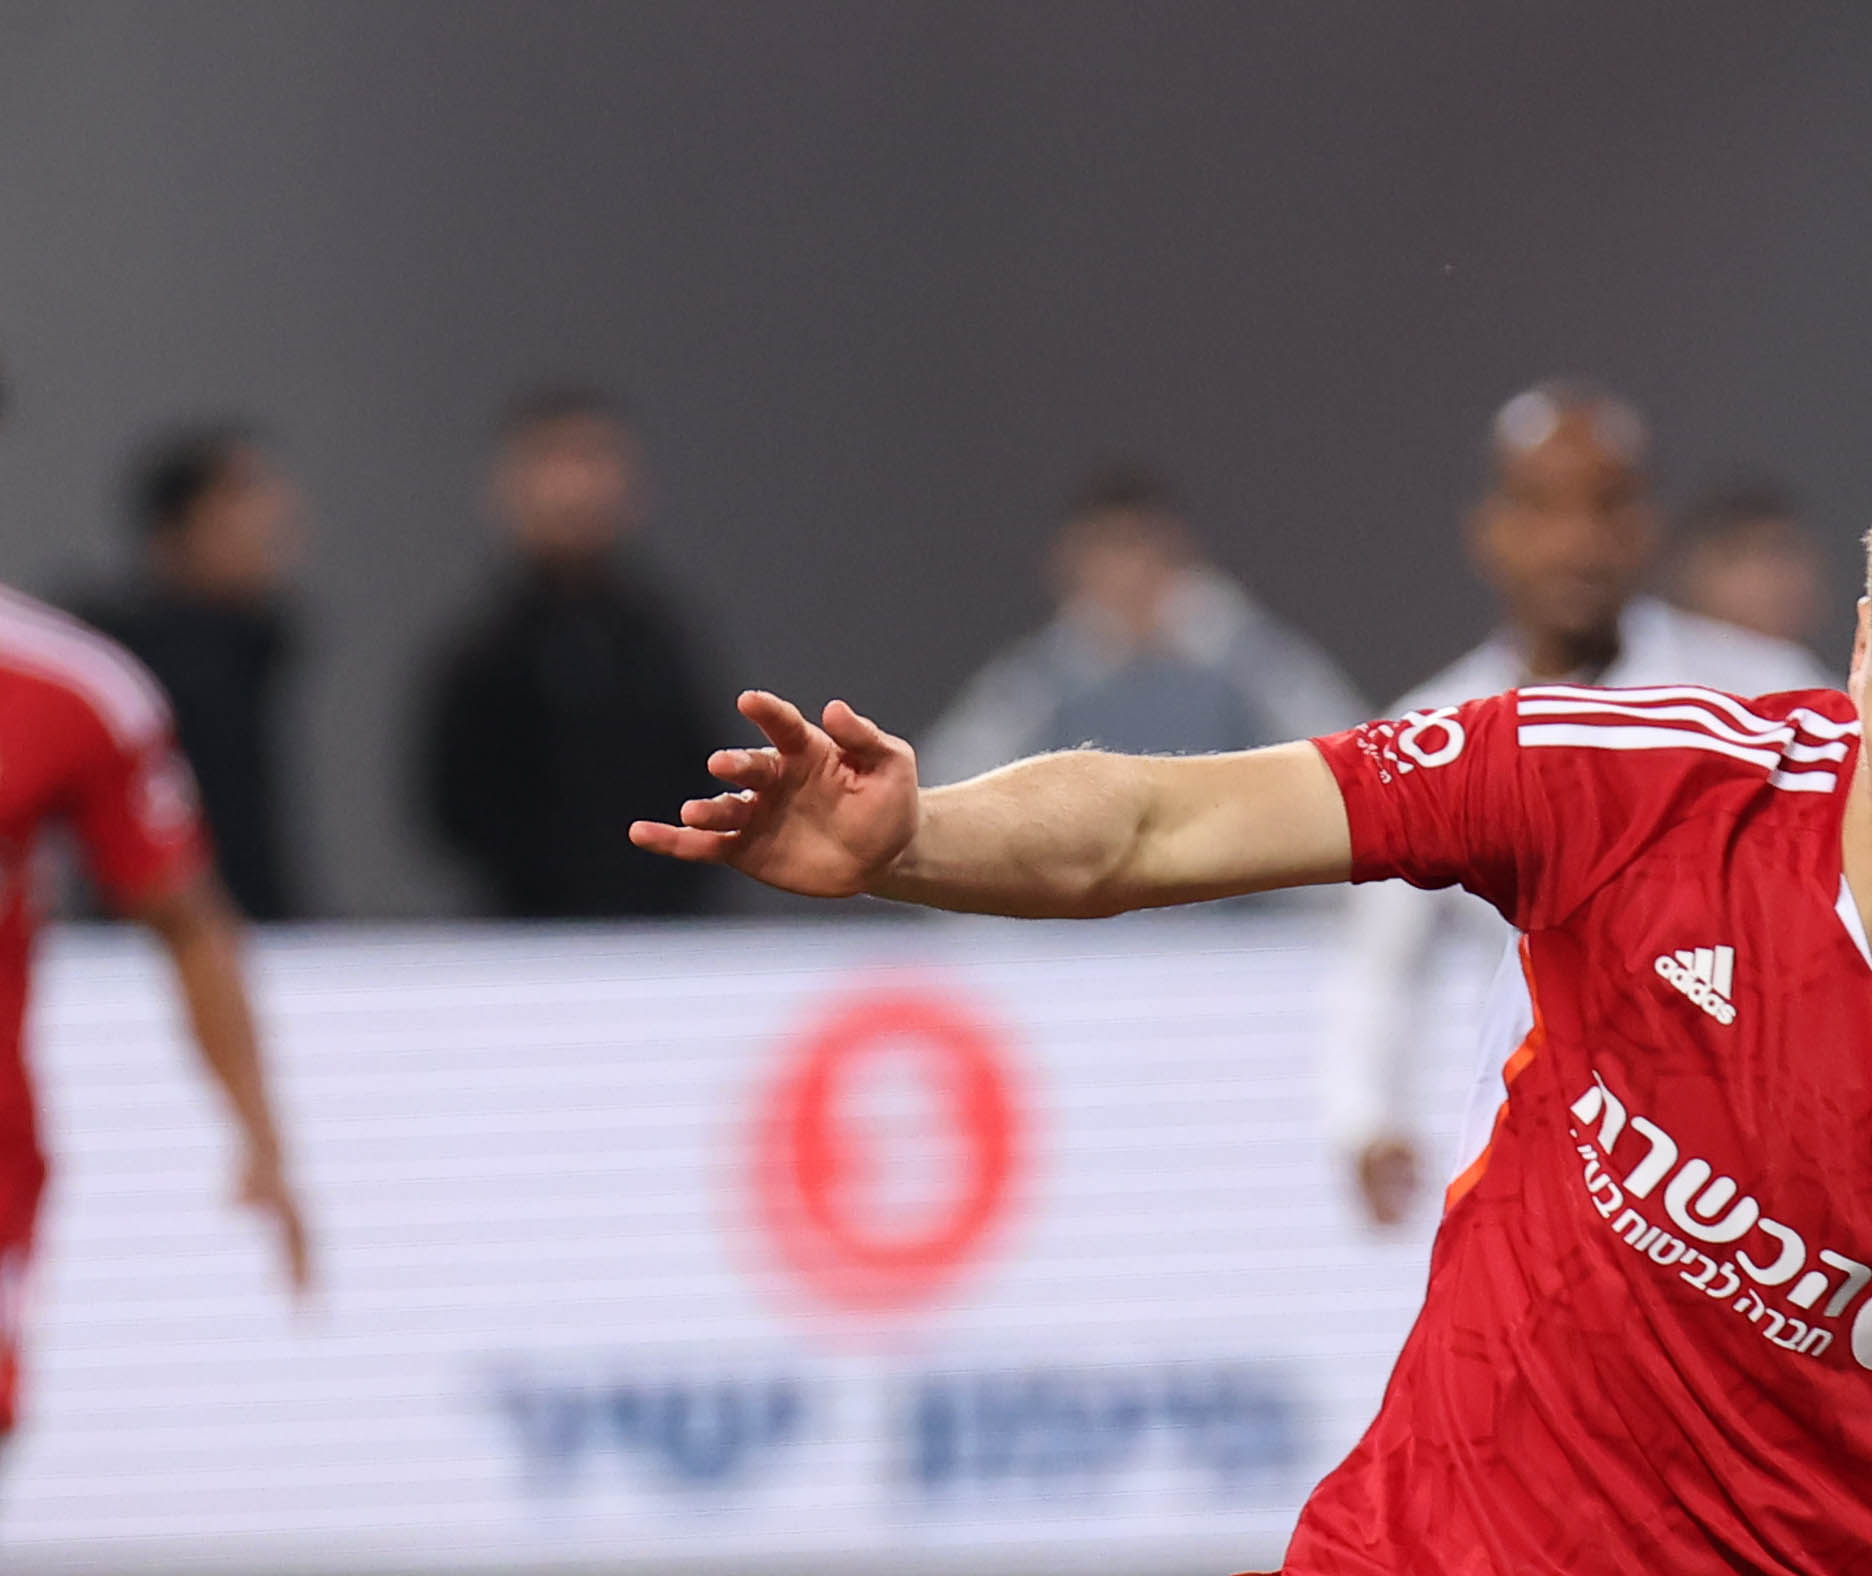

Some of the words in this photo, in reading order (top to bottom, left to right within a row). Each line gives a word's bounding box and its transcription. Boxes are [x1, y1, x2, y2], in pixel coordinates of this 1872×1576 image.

[1654, 955, 1737, 1025] adidas
[1568, 1128, 1624, 1219] בע"
[1569, 1070, 1872, 1318] הכשרה
[1611, 1208, 1741, 1298] לביטוח
[1733, 1288, 1834, 1357] חברה
